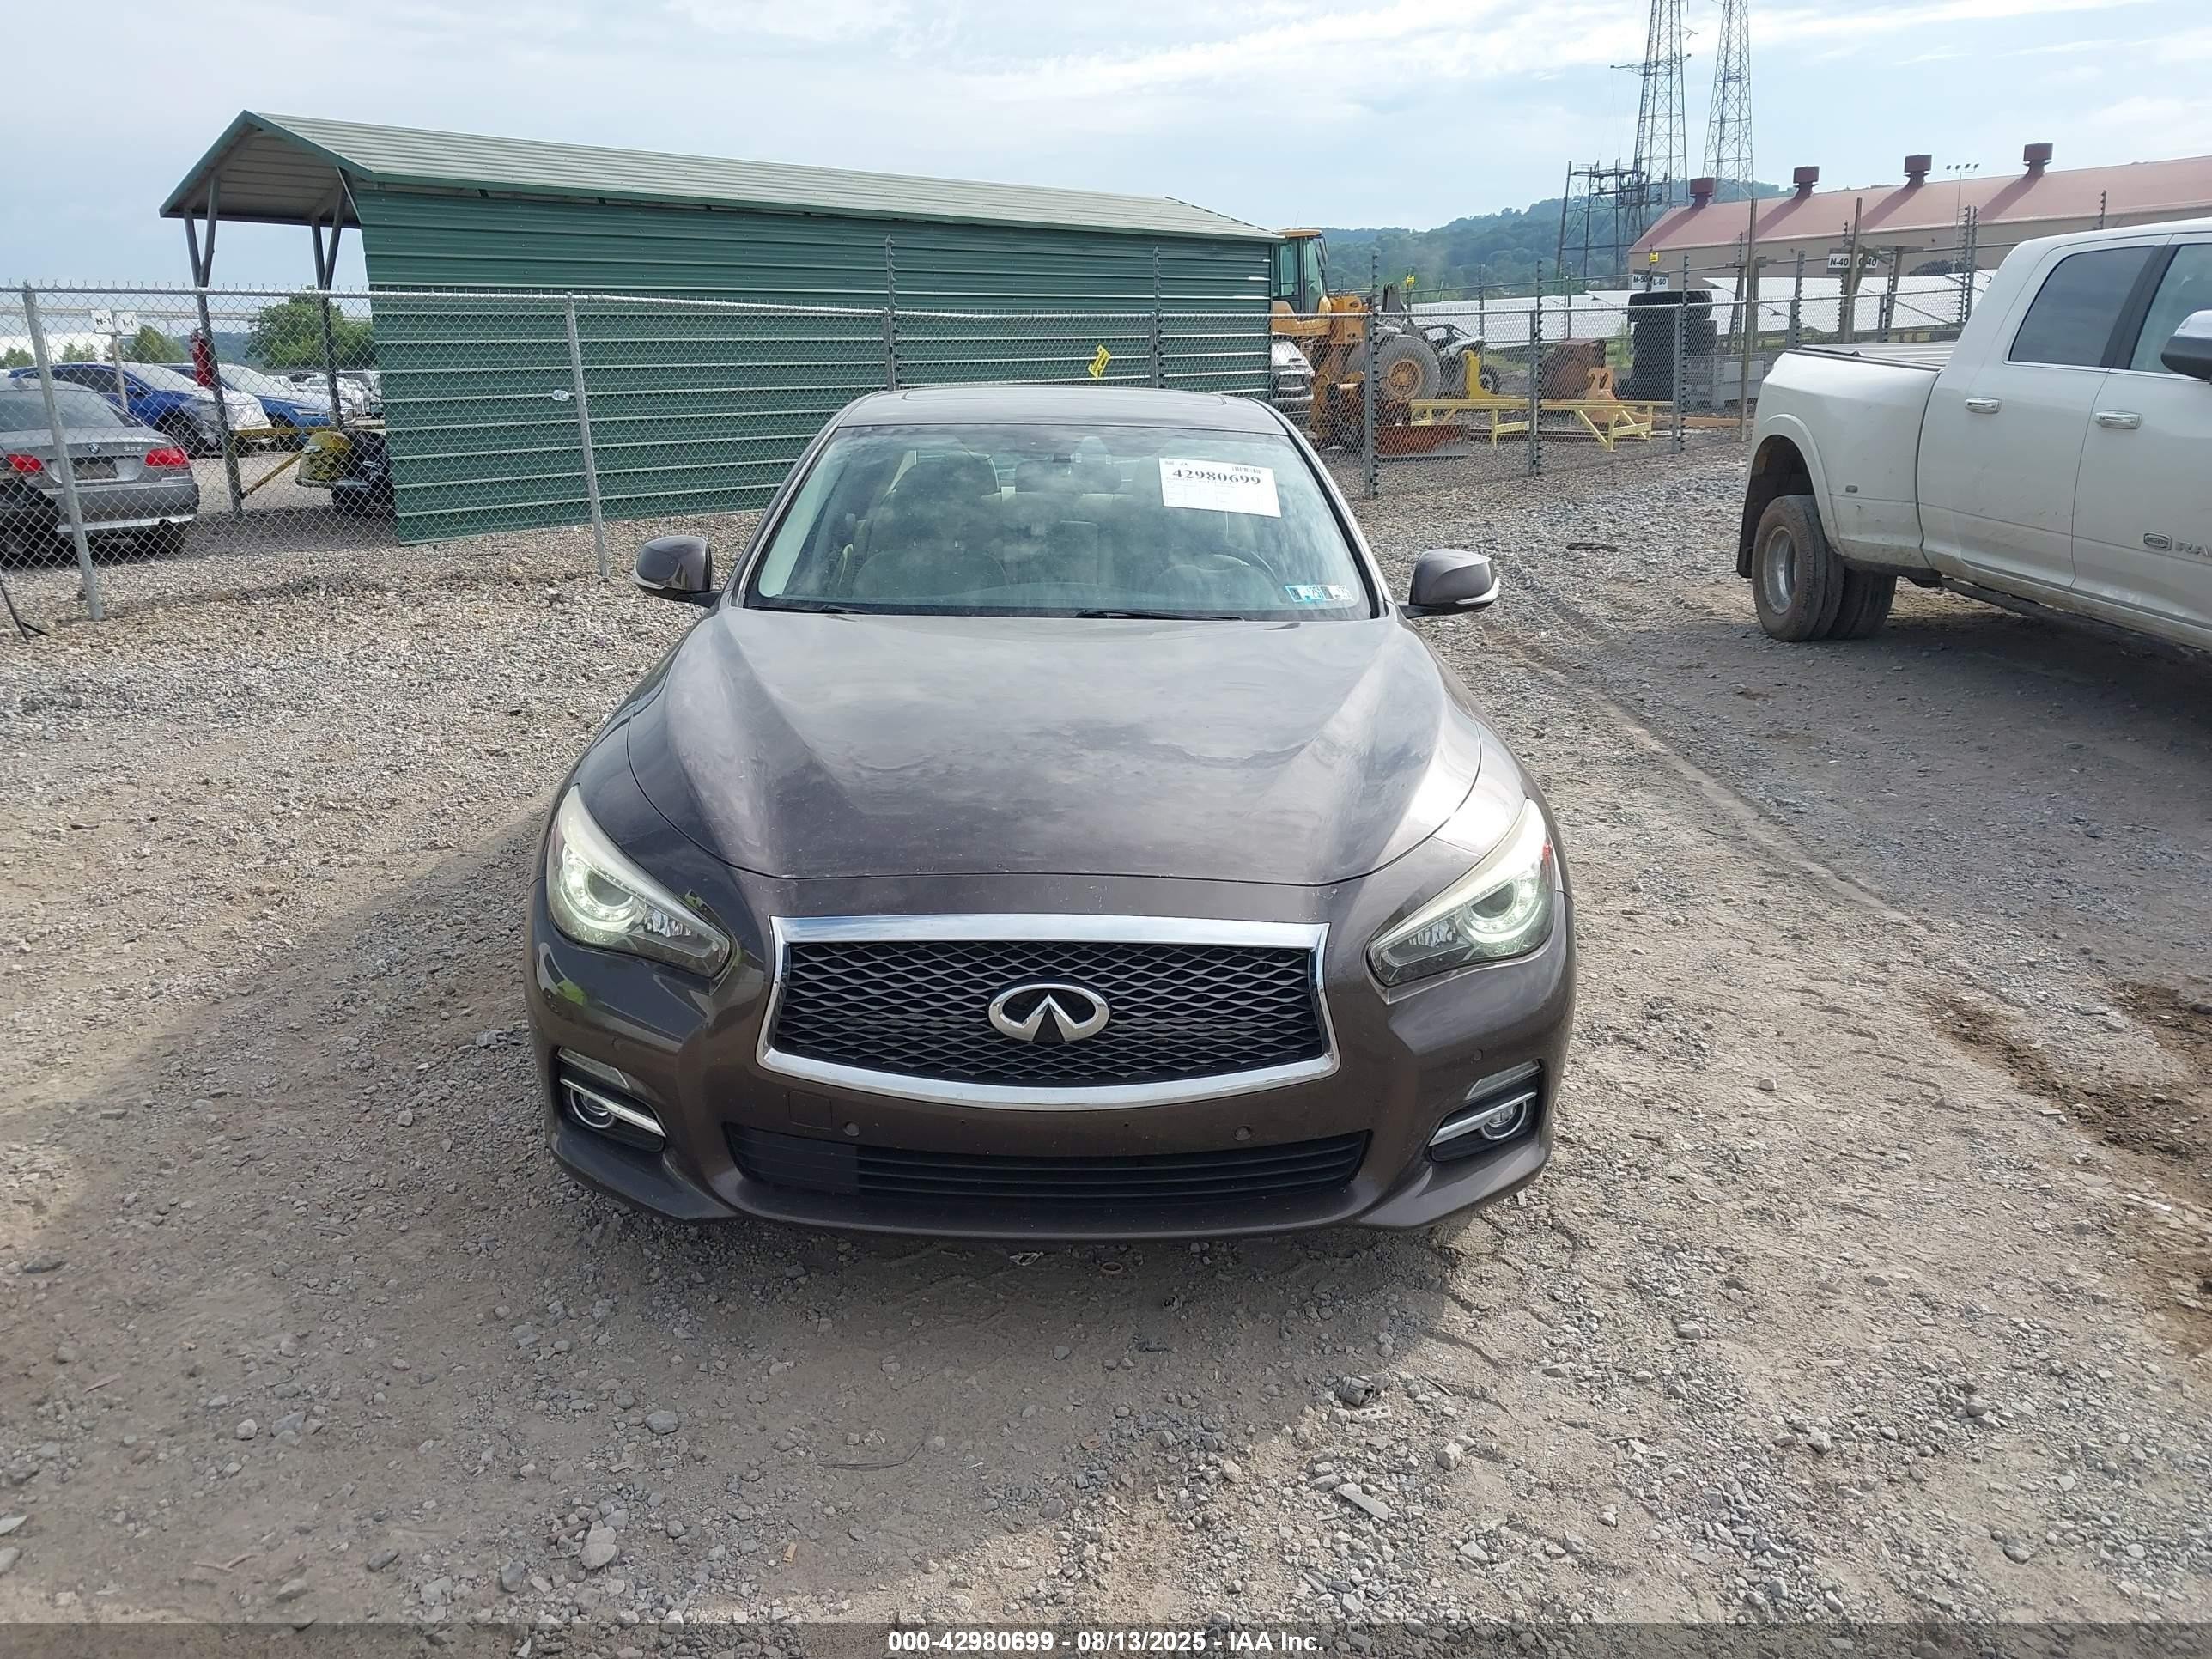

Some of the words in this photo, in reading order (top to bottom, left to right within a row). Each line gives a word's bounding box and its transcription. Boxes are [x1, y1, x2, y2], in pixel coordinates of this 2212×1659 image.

[1830, 258, 1849, 266] N-40
[95, 317, 112, 325] H-1
[1172, 469, 1261, 485] 42980699
